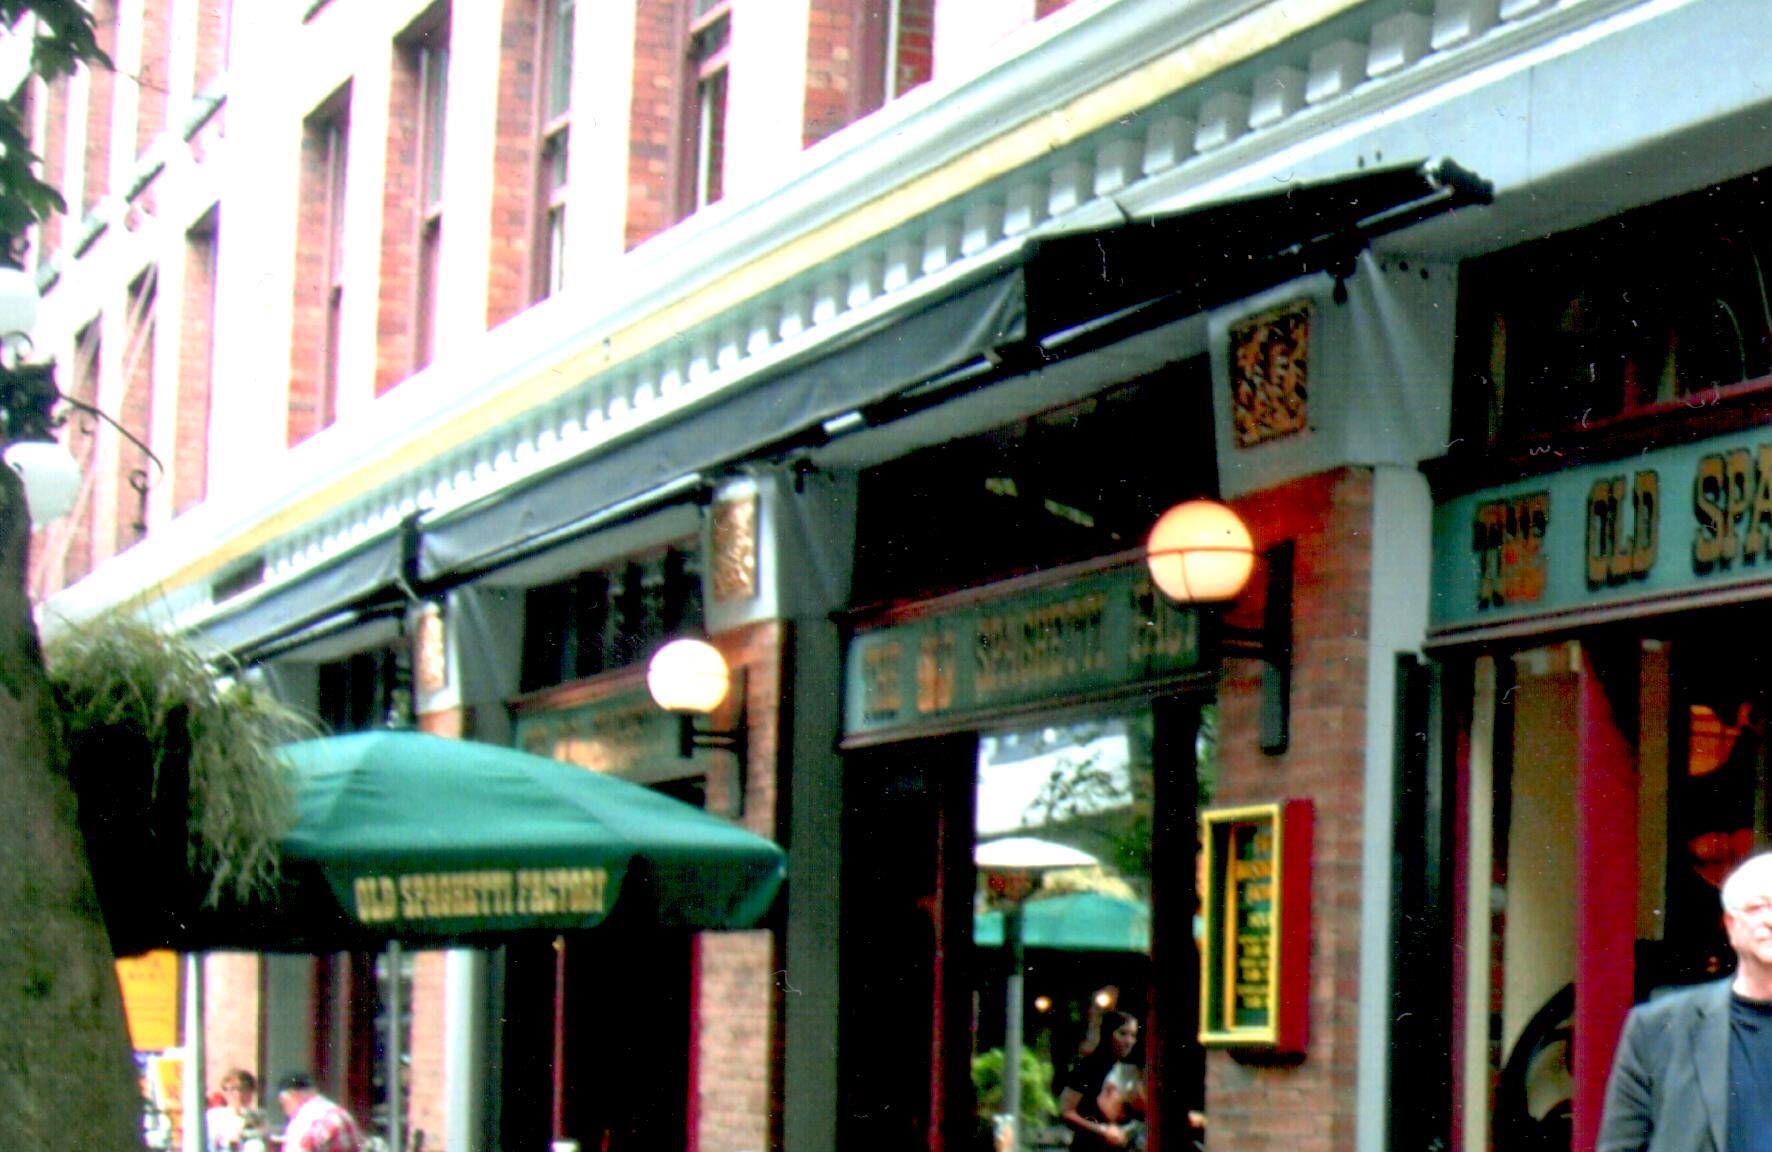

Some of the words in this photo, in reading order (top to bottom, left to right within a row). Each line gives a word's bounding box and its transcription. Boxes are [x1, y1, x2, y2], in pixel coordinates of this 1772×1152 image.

[1586, 470, 1658, 591] OLD
[354, 875, 397, 923] OLD
[399, 870, 514, 920] SPAGHETTI
